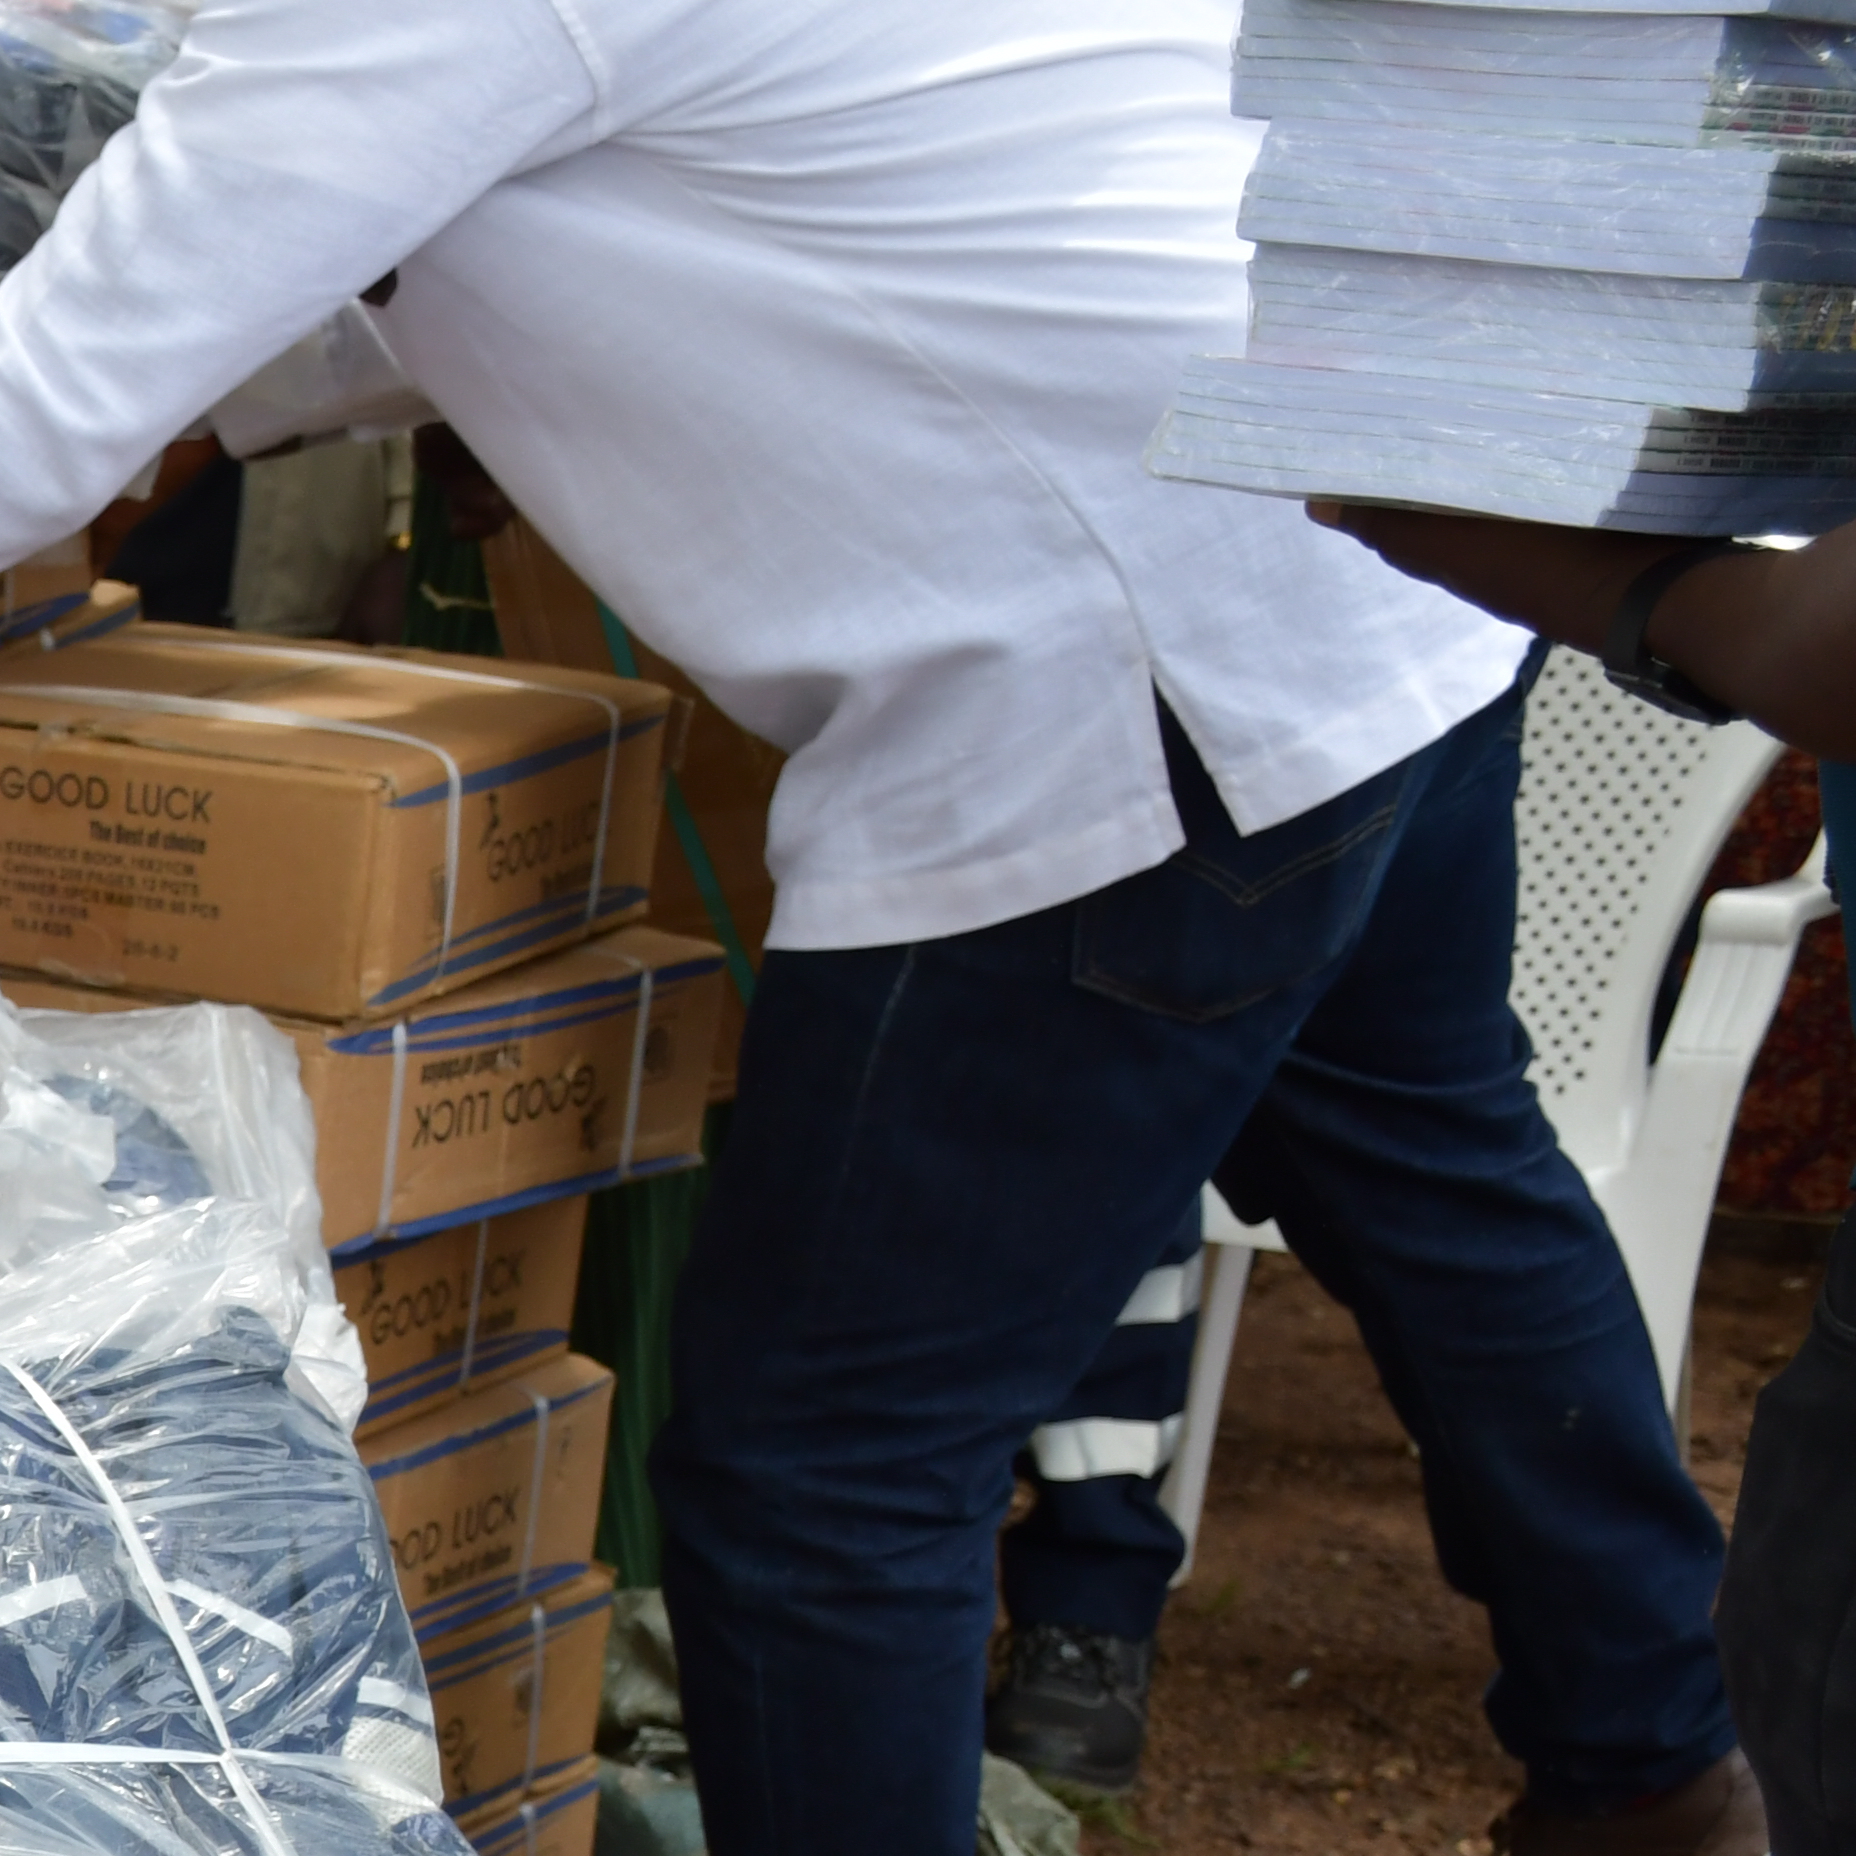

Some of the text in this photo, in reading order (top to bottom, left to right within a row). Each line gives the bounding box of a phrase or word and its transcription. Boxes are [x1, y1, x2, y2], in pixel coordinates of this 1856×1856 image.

[0, 766, 213, 823] GOOD LUCK
[411, 1066, 595, 1148] GOOD LUCK
[371, 1276, 451, 1345] GOOD
[452, 1483, 520, 1550] LUCK
